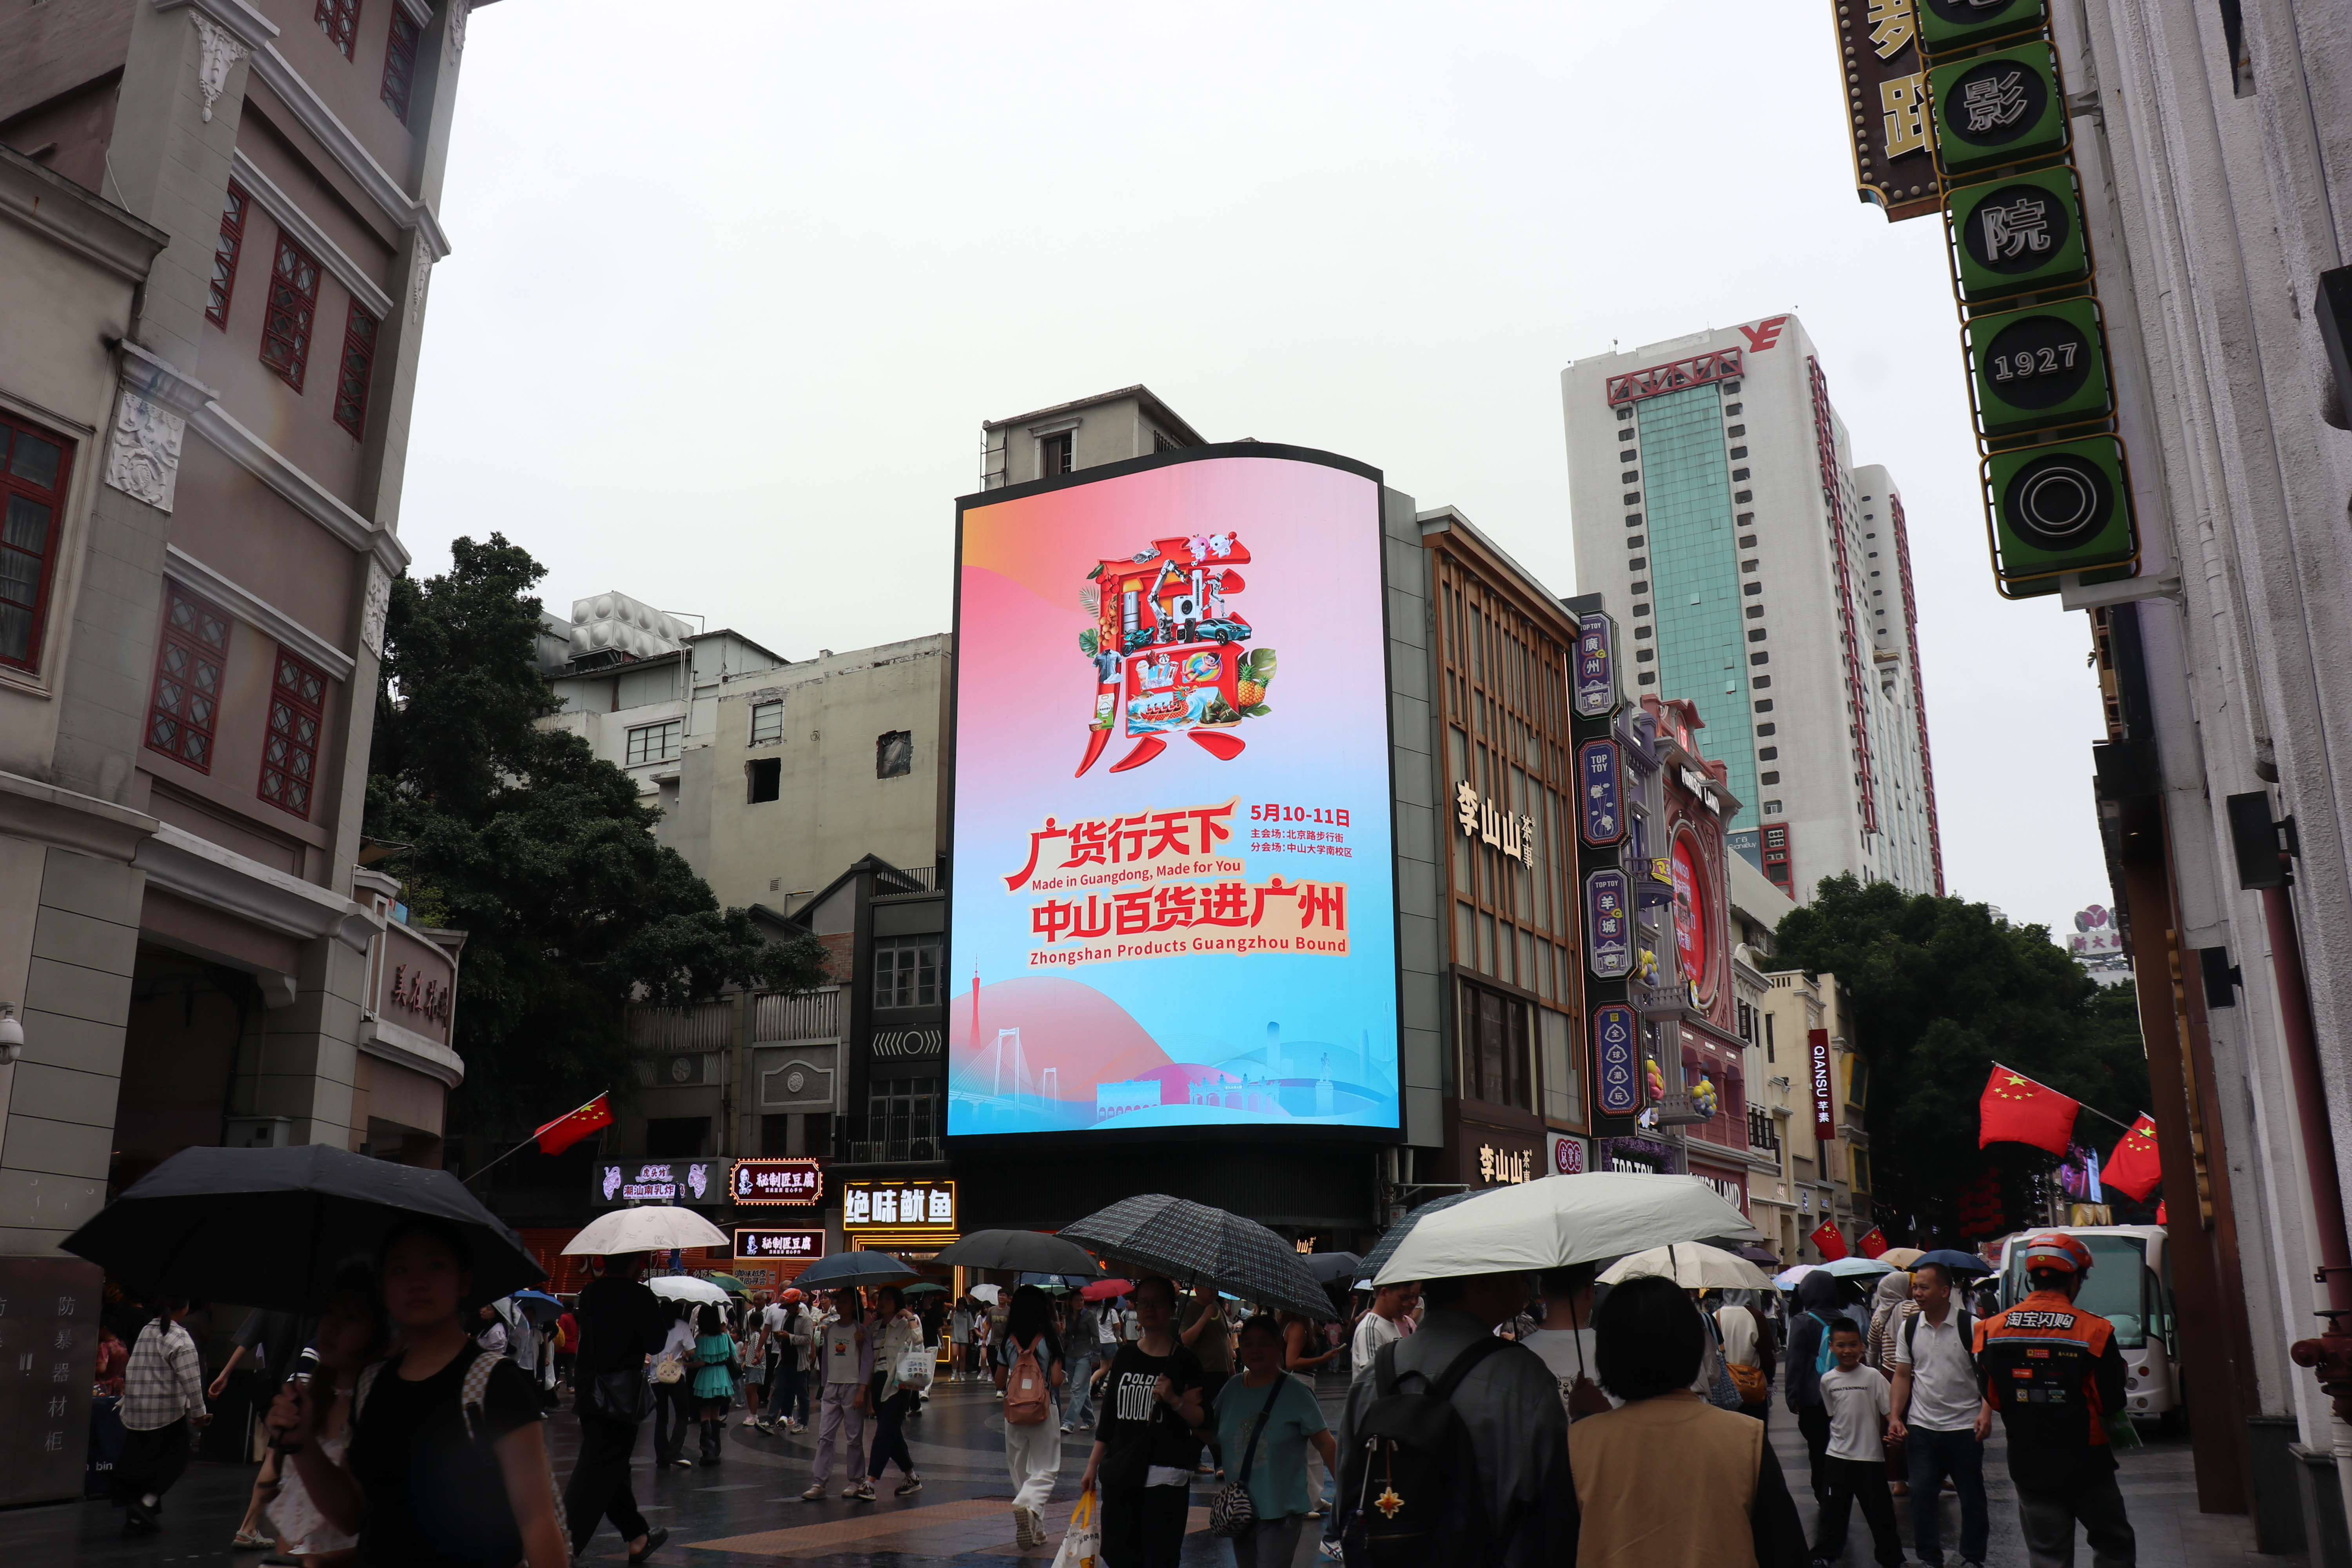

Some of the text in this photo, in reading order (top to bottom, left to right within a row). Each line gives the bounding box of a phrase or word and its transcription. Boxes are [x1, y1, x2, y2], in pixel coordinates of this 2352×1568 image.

[1994, 343, 2078, 382] 1927
[1585, 638, 1600, 673] 廣州
[1591, 754, 1607, 764] TOP
[1591, 763, 1607, 773] TOY
[1681, 765, 1720, 815] MINISO LAND
[1250, 804, 1350, 827] 5月10-11日
[1457, 779, 1521, 862] 李山山
[1004, 800, 1237, 891] 广货行天下
[1032, 860, 1241, 891] Made in Guangdong, Made for You
[1032, 878, 1344, 942] 中山百货进广州
[1601, 896, 1616, 933] 羊城
[1031, 936, 1346, 965] Zhongshan Products Guangzhou Bound
[1612, 1029, 1623, 1100] 全球潮玩
[1814, 1045, 1828, 1097] QIANSU
[643, 1168, 666, 1178] 虎头炸
[1480, 1143, 1523, 1184] 李山山
[1560, 1146, 1581, 1170] 京掌柜
[756, 1171, 815, 1187] 秘制匠豆腐
[846, 1189, 952, 1223] 绝味鱿鱼
[762, 1236, 811, 1250] 秘制匠豆腐
[735, 1269, 767, 1278] 咖味越秀
[2005, 1311, 2074, 1328] 淘宝闪购
[44, 1296, 76, 1452] 防暴器材柜
[96, 1461, 113, 1471] bin
